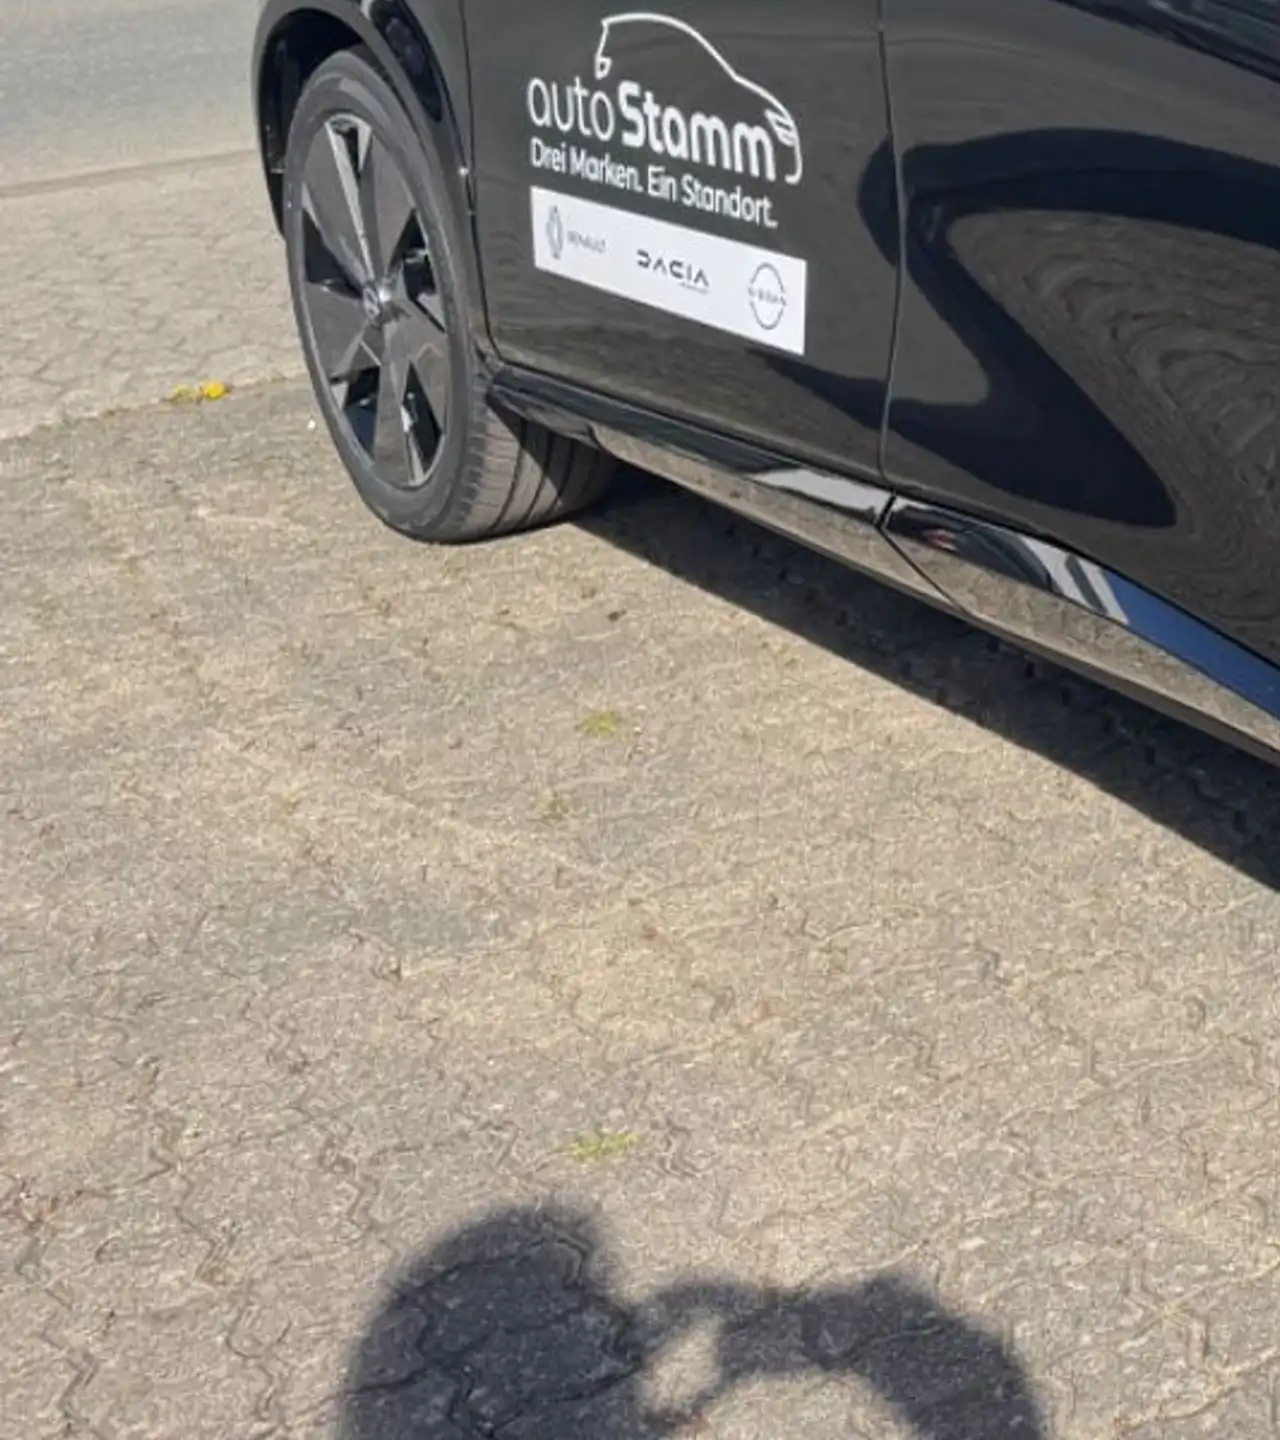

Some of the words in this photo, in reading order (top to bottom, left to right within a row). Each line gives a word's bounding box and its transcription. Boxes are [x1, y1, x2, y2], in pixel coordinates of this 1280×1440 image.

[530, 136, 566, 173] Drei
[570, 145, 644, 192] Marken.
[648, 164, 677, 203] Ein
[681, 173, 779, 229] Standort.
[636, 248, 710, 288] DACIA
